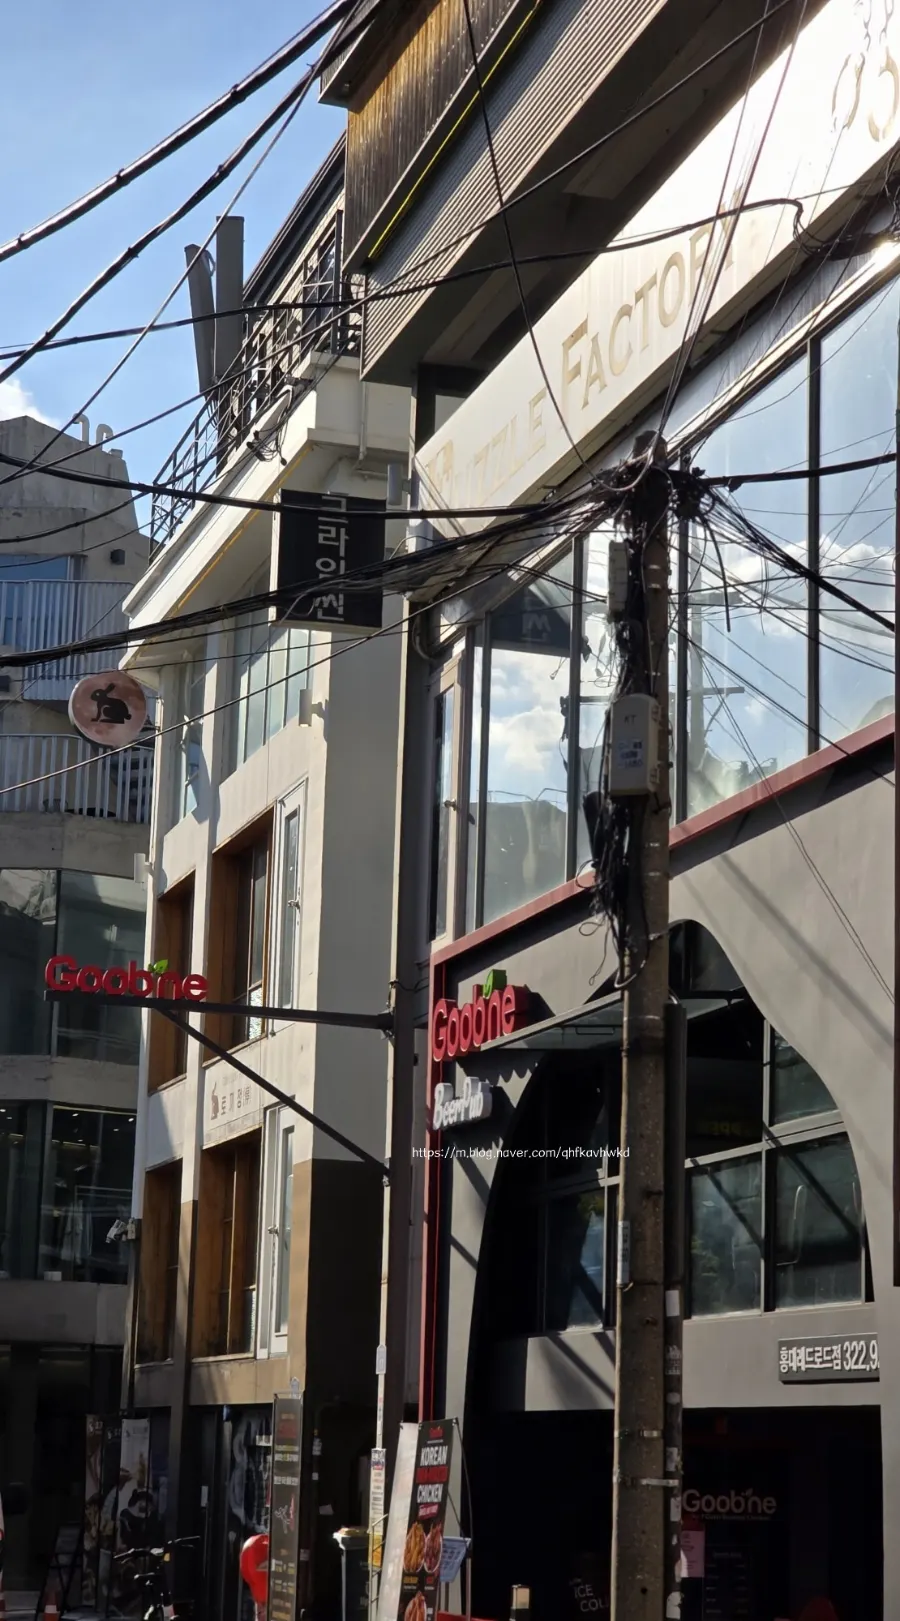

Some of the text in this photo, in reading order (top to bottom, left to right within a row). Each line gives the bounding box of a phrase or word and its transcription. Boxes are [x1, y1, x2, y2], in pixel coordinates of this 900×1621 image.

[561, 188, 745, 410] FACTORY
[45, 955, 209, 1001] Goobne
[433, 983, 518, 1062] Goobne
[779, 1344, 841, 1373] 홍대레드로드점
[420, 1446, 448, 1466] KOREAN
[417, 1484, 443, 1503] CHICKEN
[682, 1488, 777, 1515] Goobne
